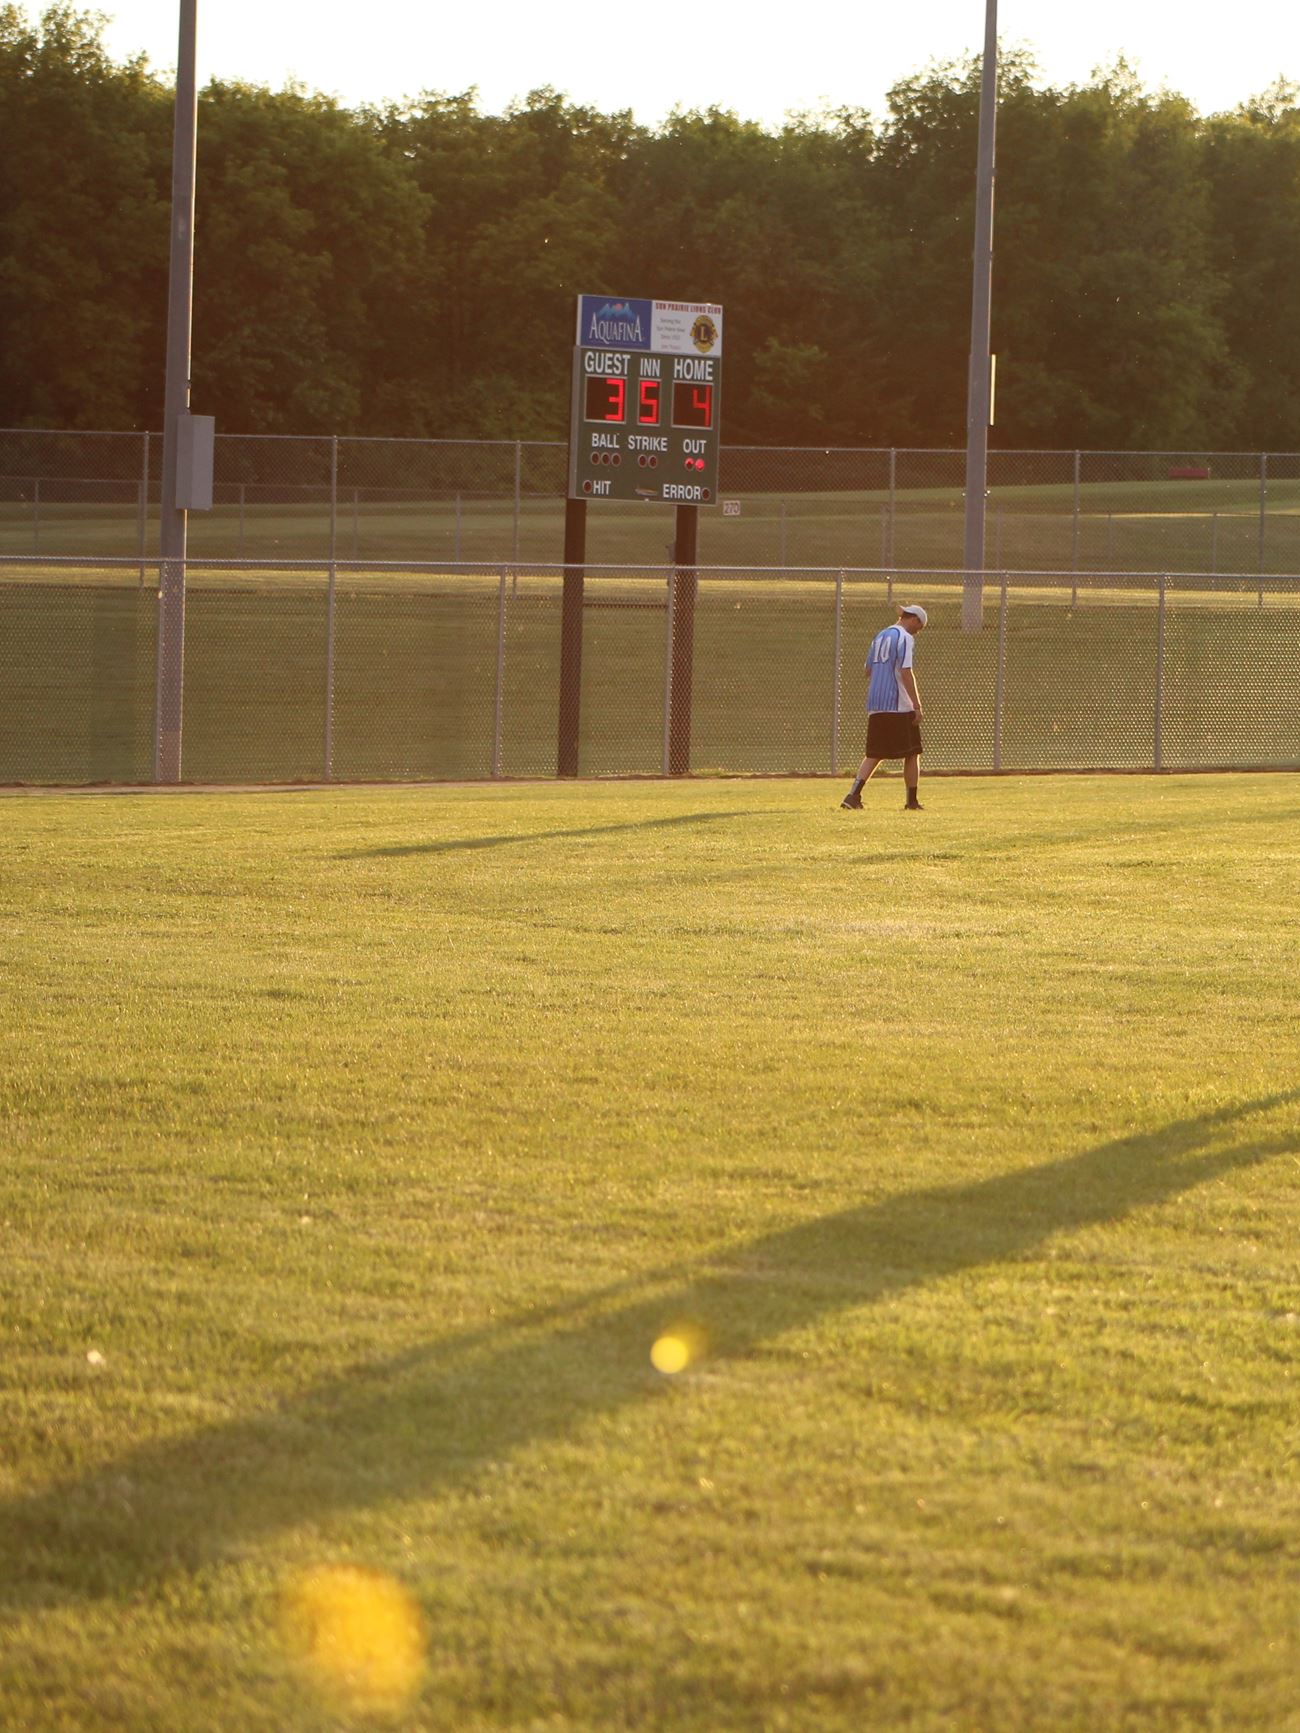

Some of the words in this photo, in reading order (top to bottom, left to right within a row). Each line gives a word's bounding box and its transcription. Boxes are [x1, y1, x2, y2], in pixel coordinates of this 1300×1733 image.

[589, 312, 642, 344] AQUAFINA
[585, 352, 630, 375] GUEST
[640, 358, 660, 377] INN
[674, 358, 713, 380] HOME
[605, 378, 625, 421] 3
[639, 380, 658, 423] 5
[693, 384, 711, 426] 4
[592, 433, 619, 449] BALL
[628, 435, 668, 451] STRIKE
[683, 439, 707, 454] OUT
[593, 480, 611, 495] HIT
[663, 484, 701, 500] ERROR
[873, 635, 892, 663] 10
